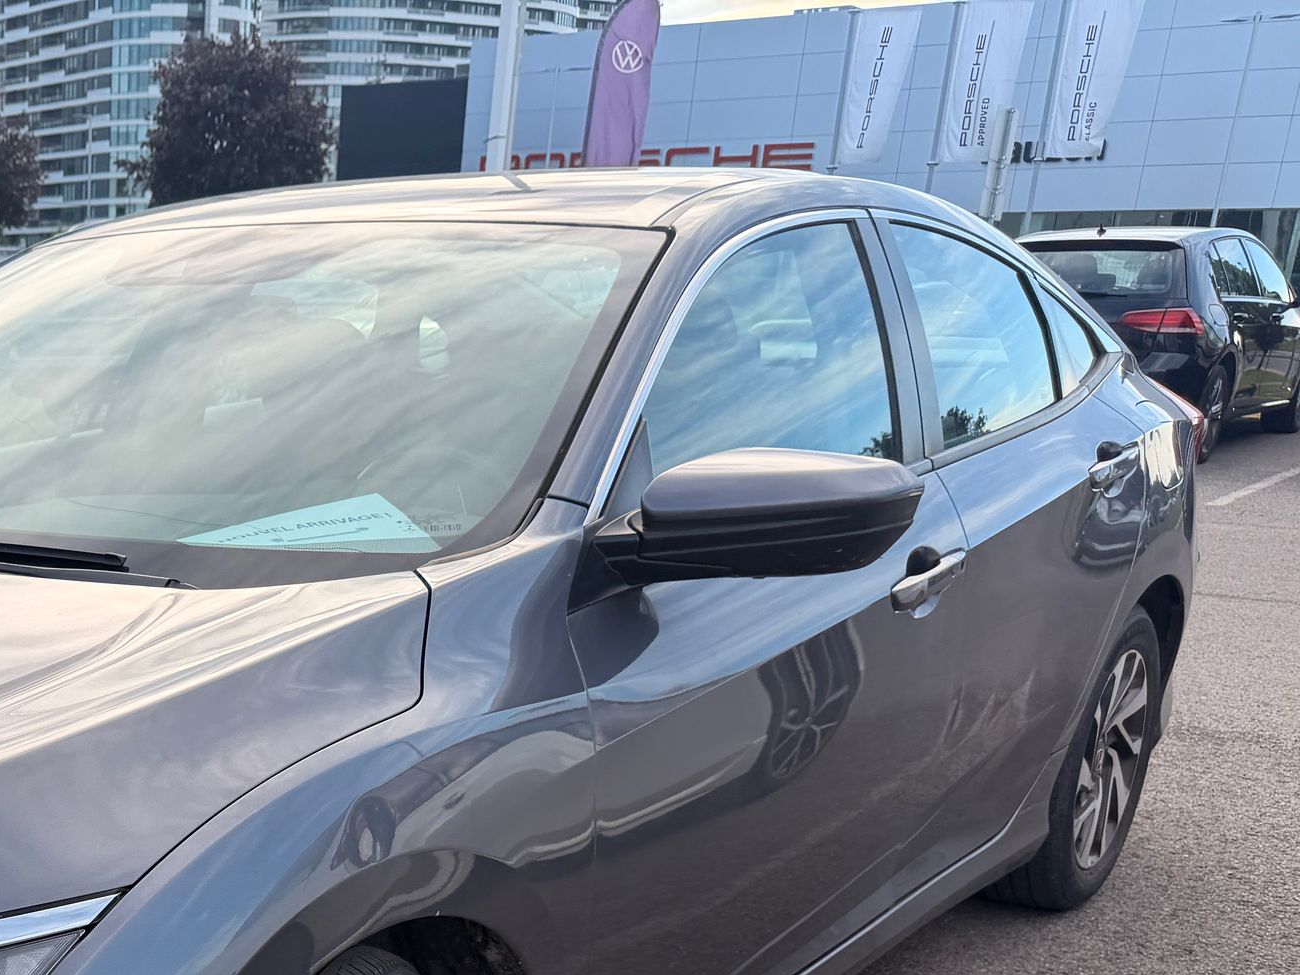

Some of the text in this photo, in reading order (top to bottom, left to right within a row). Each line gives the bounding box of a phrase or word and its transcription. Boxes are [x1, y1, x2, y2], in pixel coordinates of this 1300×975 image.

[856, 26, 893, 149] PORSCHE
[959, 33, 987, 147] PORSCHE
[977, 97, 990, 147] APPROVED
[1067, 24, 1098, 142] PORSCHE
[479, 142, 815, 171] OCHE
